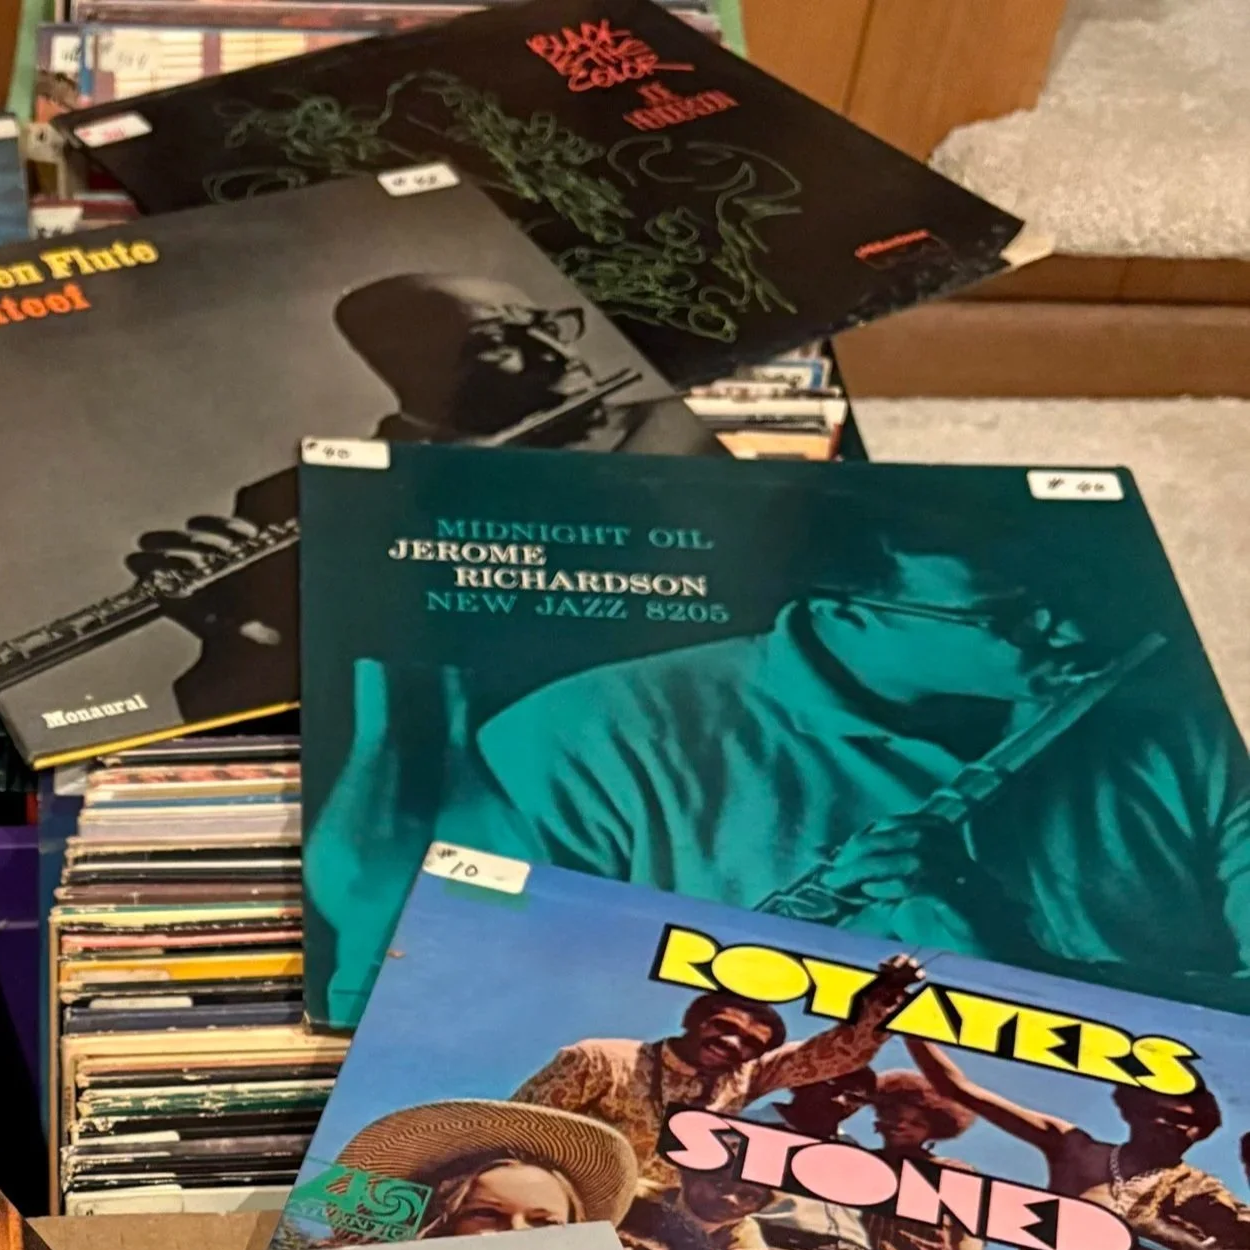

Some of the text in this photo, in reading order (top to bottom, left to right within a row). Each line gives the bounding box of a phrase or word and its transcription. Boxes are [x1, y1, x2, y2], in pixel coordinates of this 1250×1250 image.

[40, 240, 159, 281] Flute
[436, 518, 715, 550] MIDNIGHT OIL
[388, 538, 548, 566] JEROME
[454, 566, 708, 597] RICHARDSON
[426, 591, 730, 624] NEW JAZZ 8205
[41, 694, 148, 729] Monaural
[650, 924, 1205, 1097] ROY AYERS
